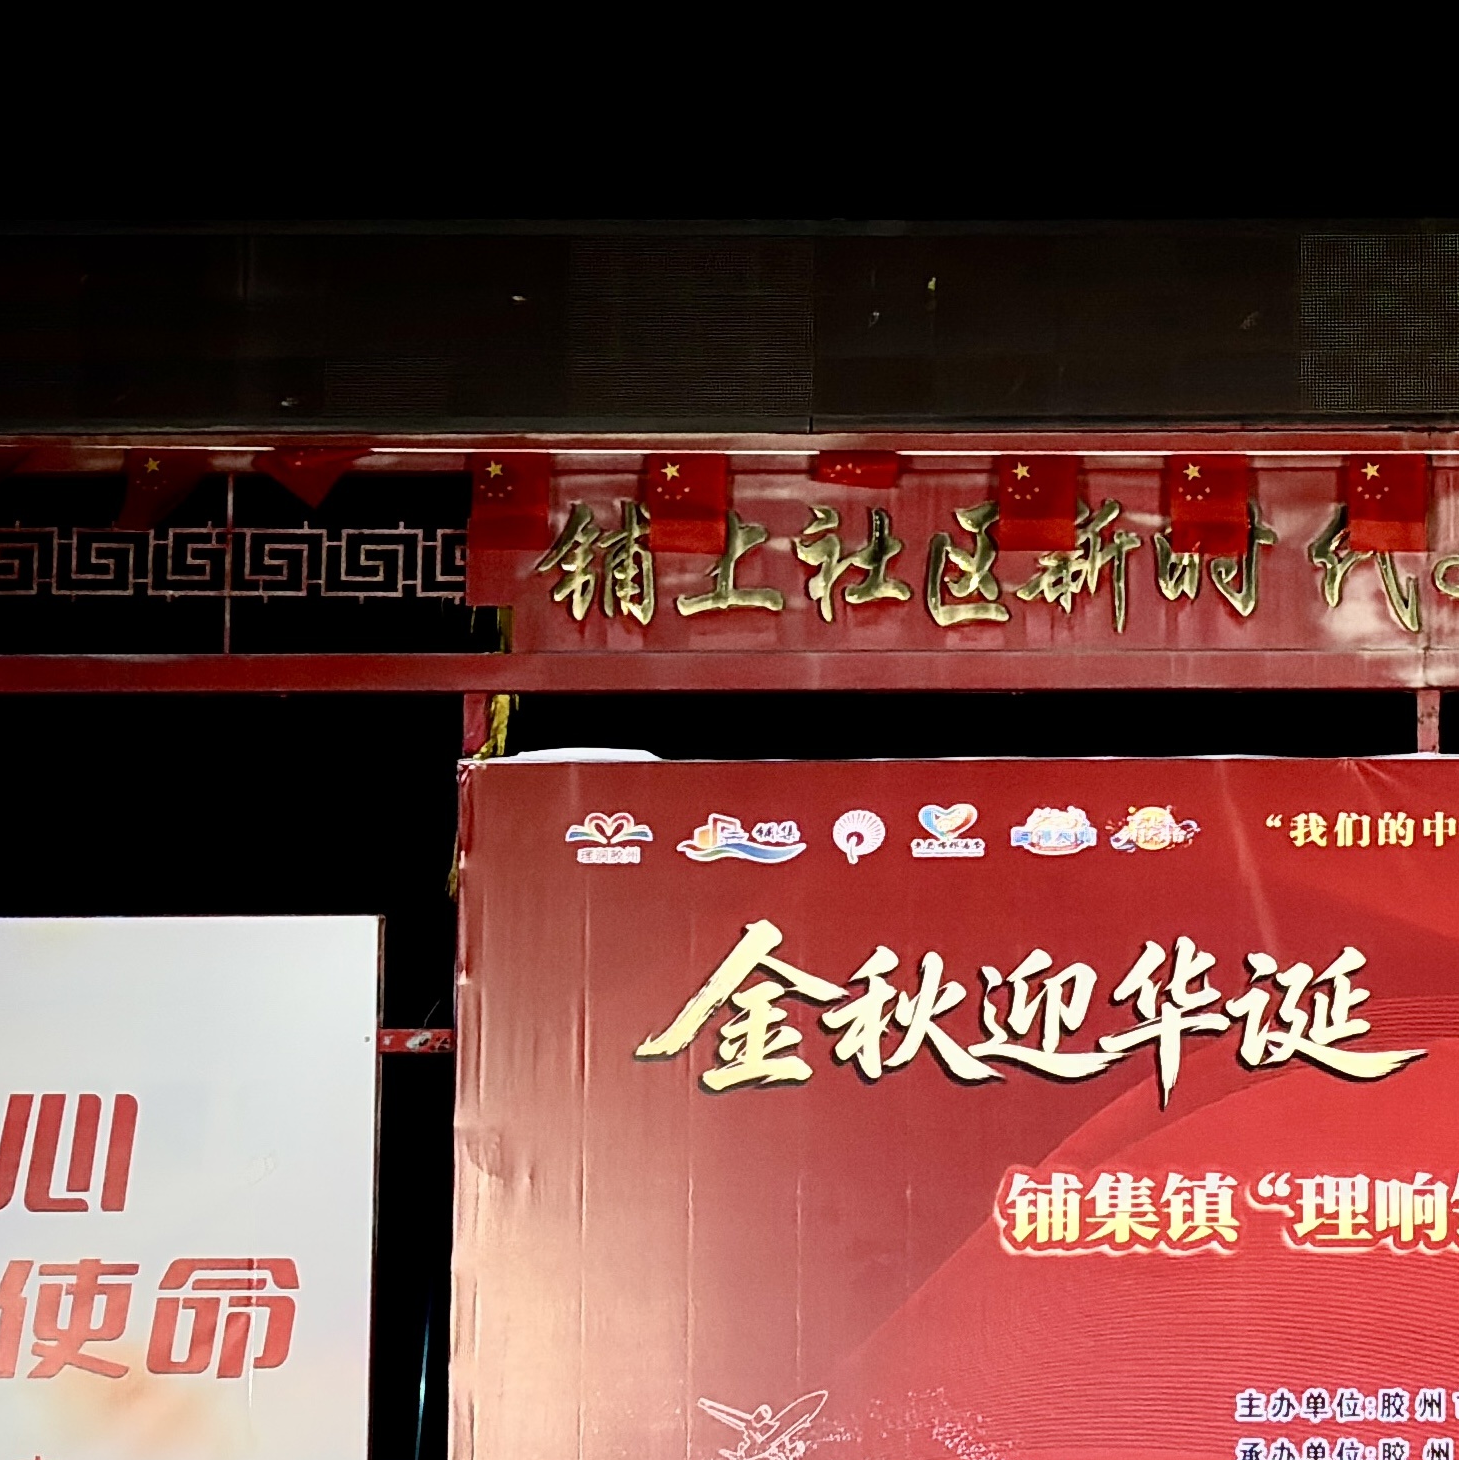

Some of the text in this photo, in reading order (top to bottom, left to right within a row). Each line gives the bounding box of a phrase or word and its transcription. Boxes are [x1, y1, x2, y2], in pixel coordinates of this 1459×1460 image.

[635, 919, 1427, 1107] 金秋迎华诞
